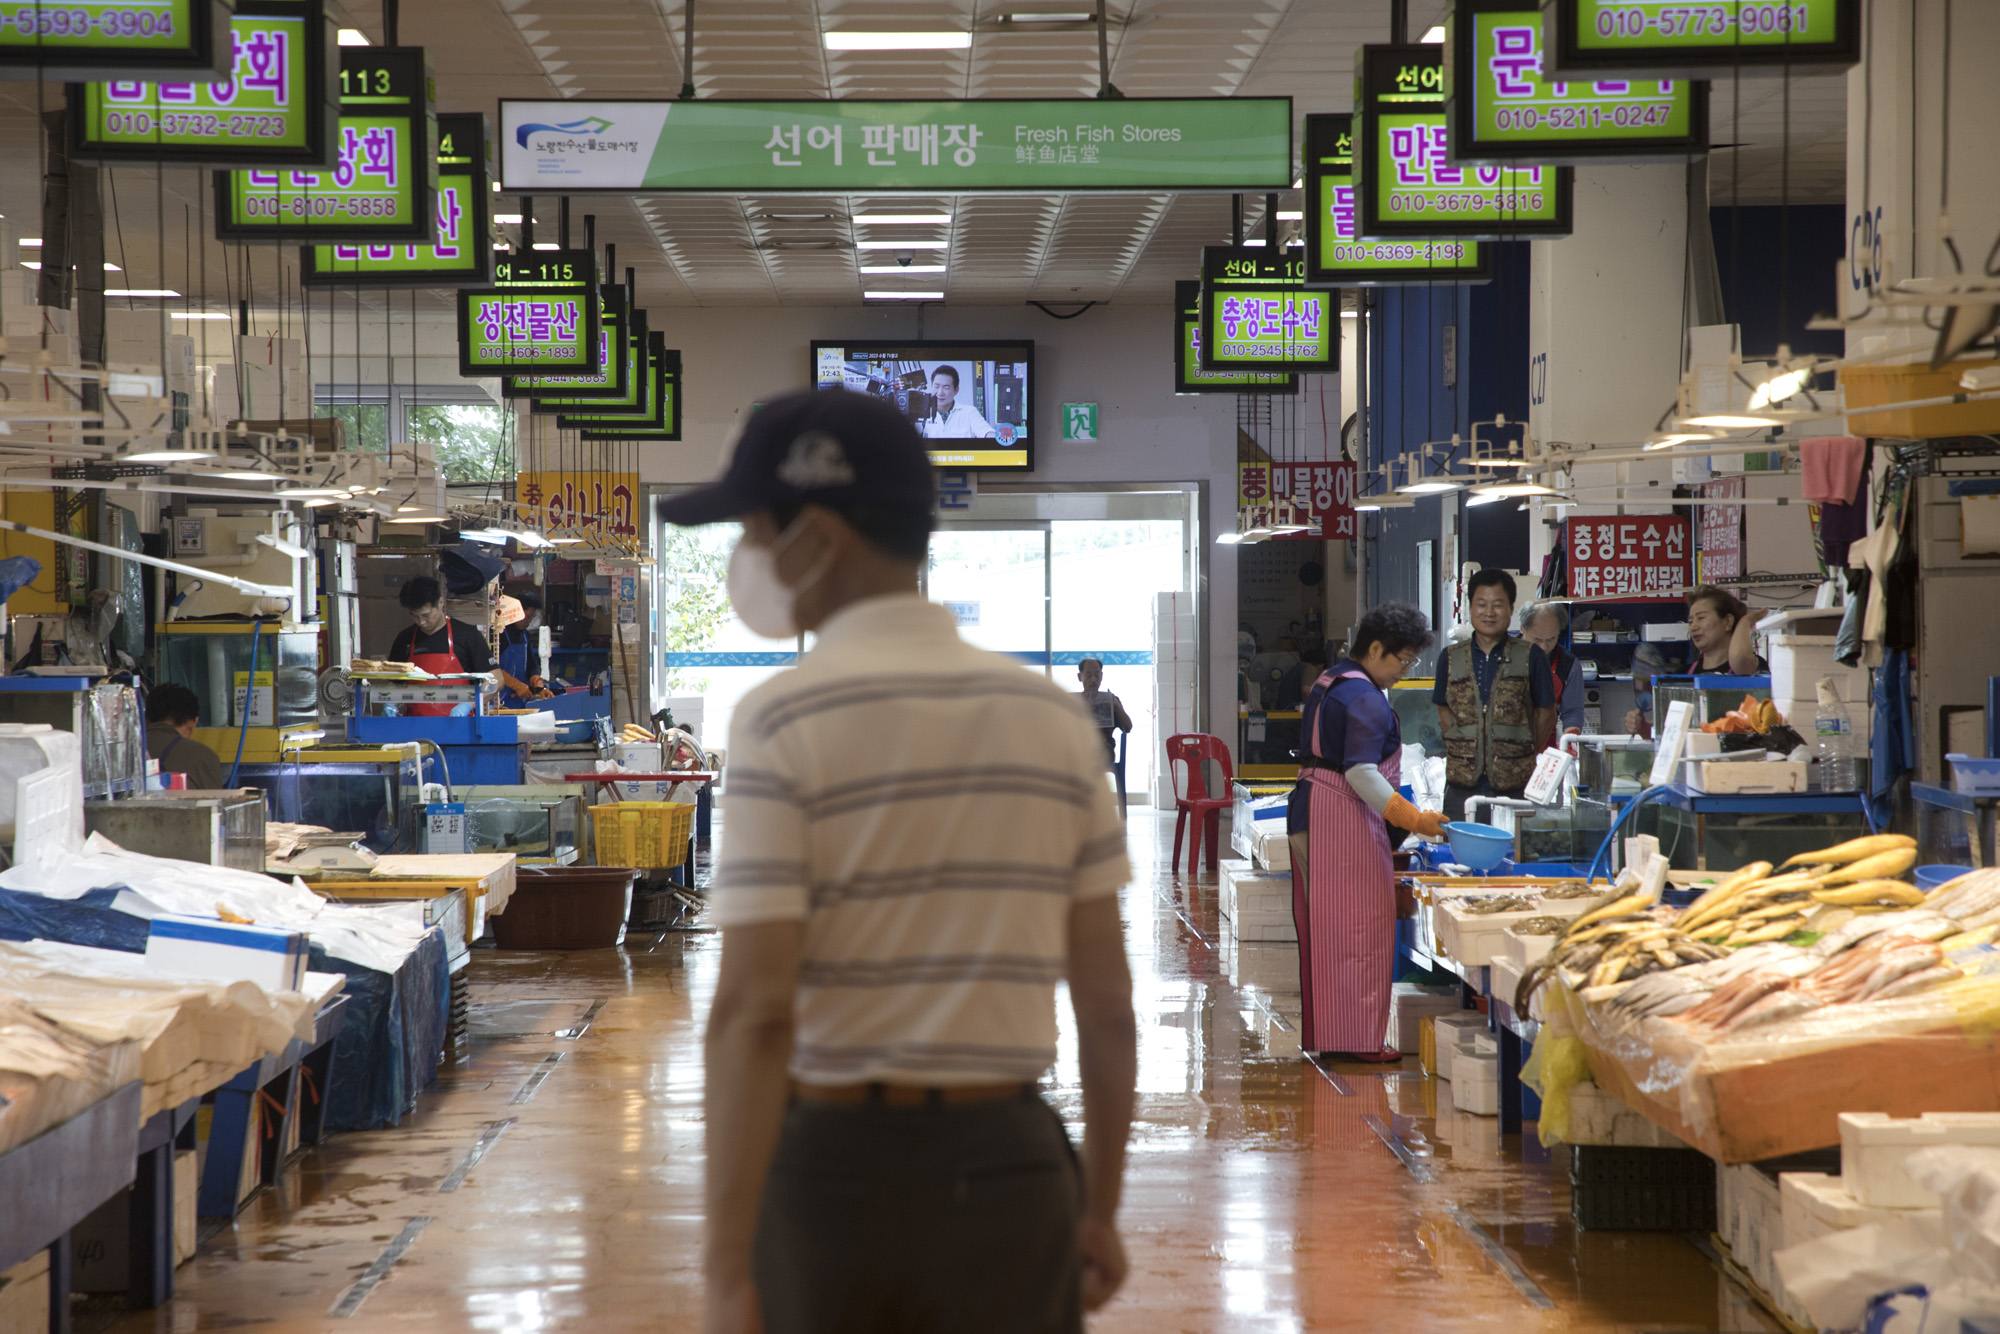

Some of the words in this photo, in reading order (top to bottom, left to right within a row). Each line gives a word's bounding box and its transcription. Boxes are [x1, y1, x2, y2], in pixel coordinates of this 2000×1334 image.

[1596, 6, 1808, 37] 010-5773-9061
[106, 112, 287, 138] 010-3732-2723
[1496, 104, 1672, 130] 010-5211-0247
[1015, 125, 1068, 142] Fresh
[1076, 125, 1115, 142] Fish
[1122, 124, 1182, 142] Stores
[536, 139, 638, 153] 노량진수산물도매시장
[764, 124, 842, 166] 선어
[861, 124, 984, 167] 판매장
[246, 197, 397, 217] 010-8107-5858
[1390, 193, 1543, 213] 010-3679-5816
[1335, 245, 1465, 262] 010-6369-2198
[539, 263, 573, 280] 115
[1224, 259, 1257, 277] 선어
[1285, 260, 1305, 277] 10
[1221, 297, 1321, 339] 충청도수산
[479, 347, 577, 359] 010-4606-1893
[1222, 344, 1319, 357] 010-2545-5762
[1531, 352, 1547, 406] C27
[1574, 523, 1685, 561] 충청도수산
[1573, 566, 1600, 597] 제주
[1603, 566, 1642, 597] 은갈치
[1644, 566, 1685, 597] 전문점
